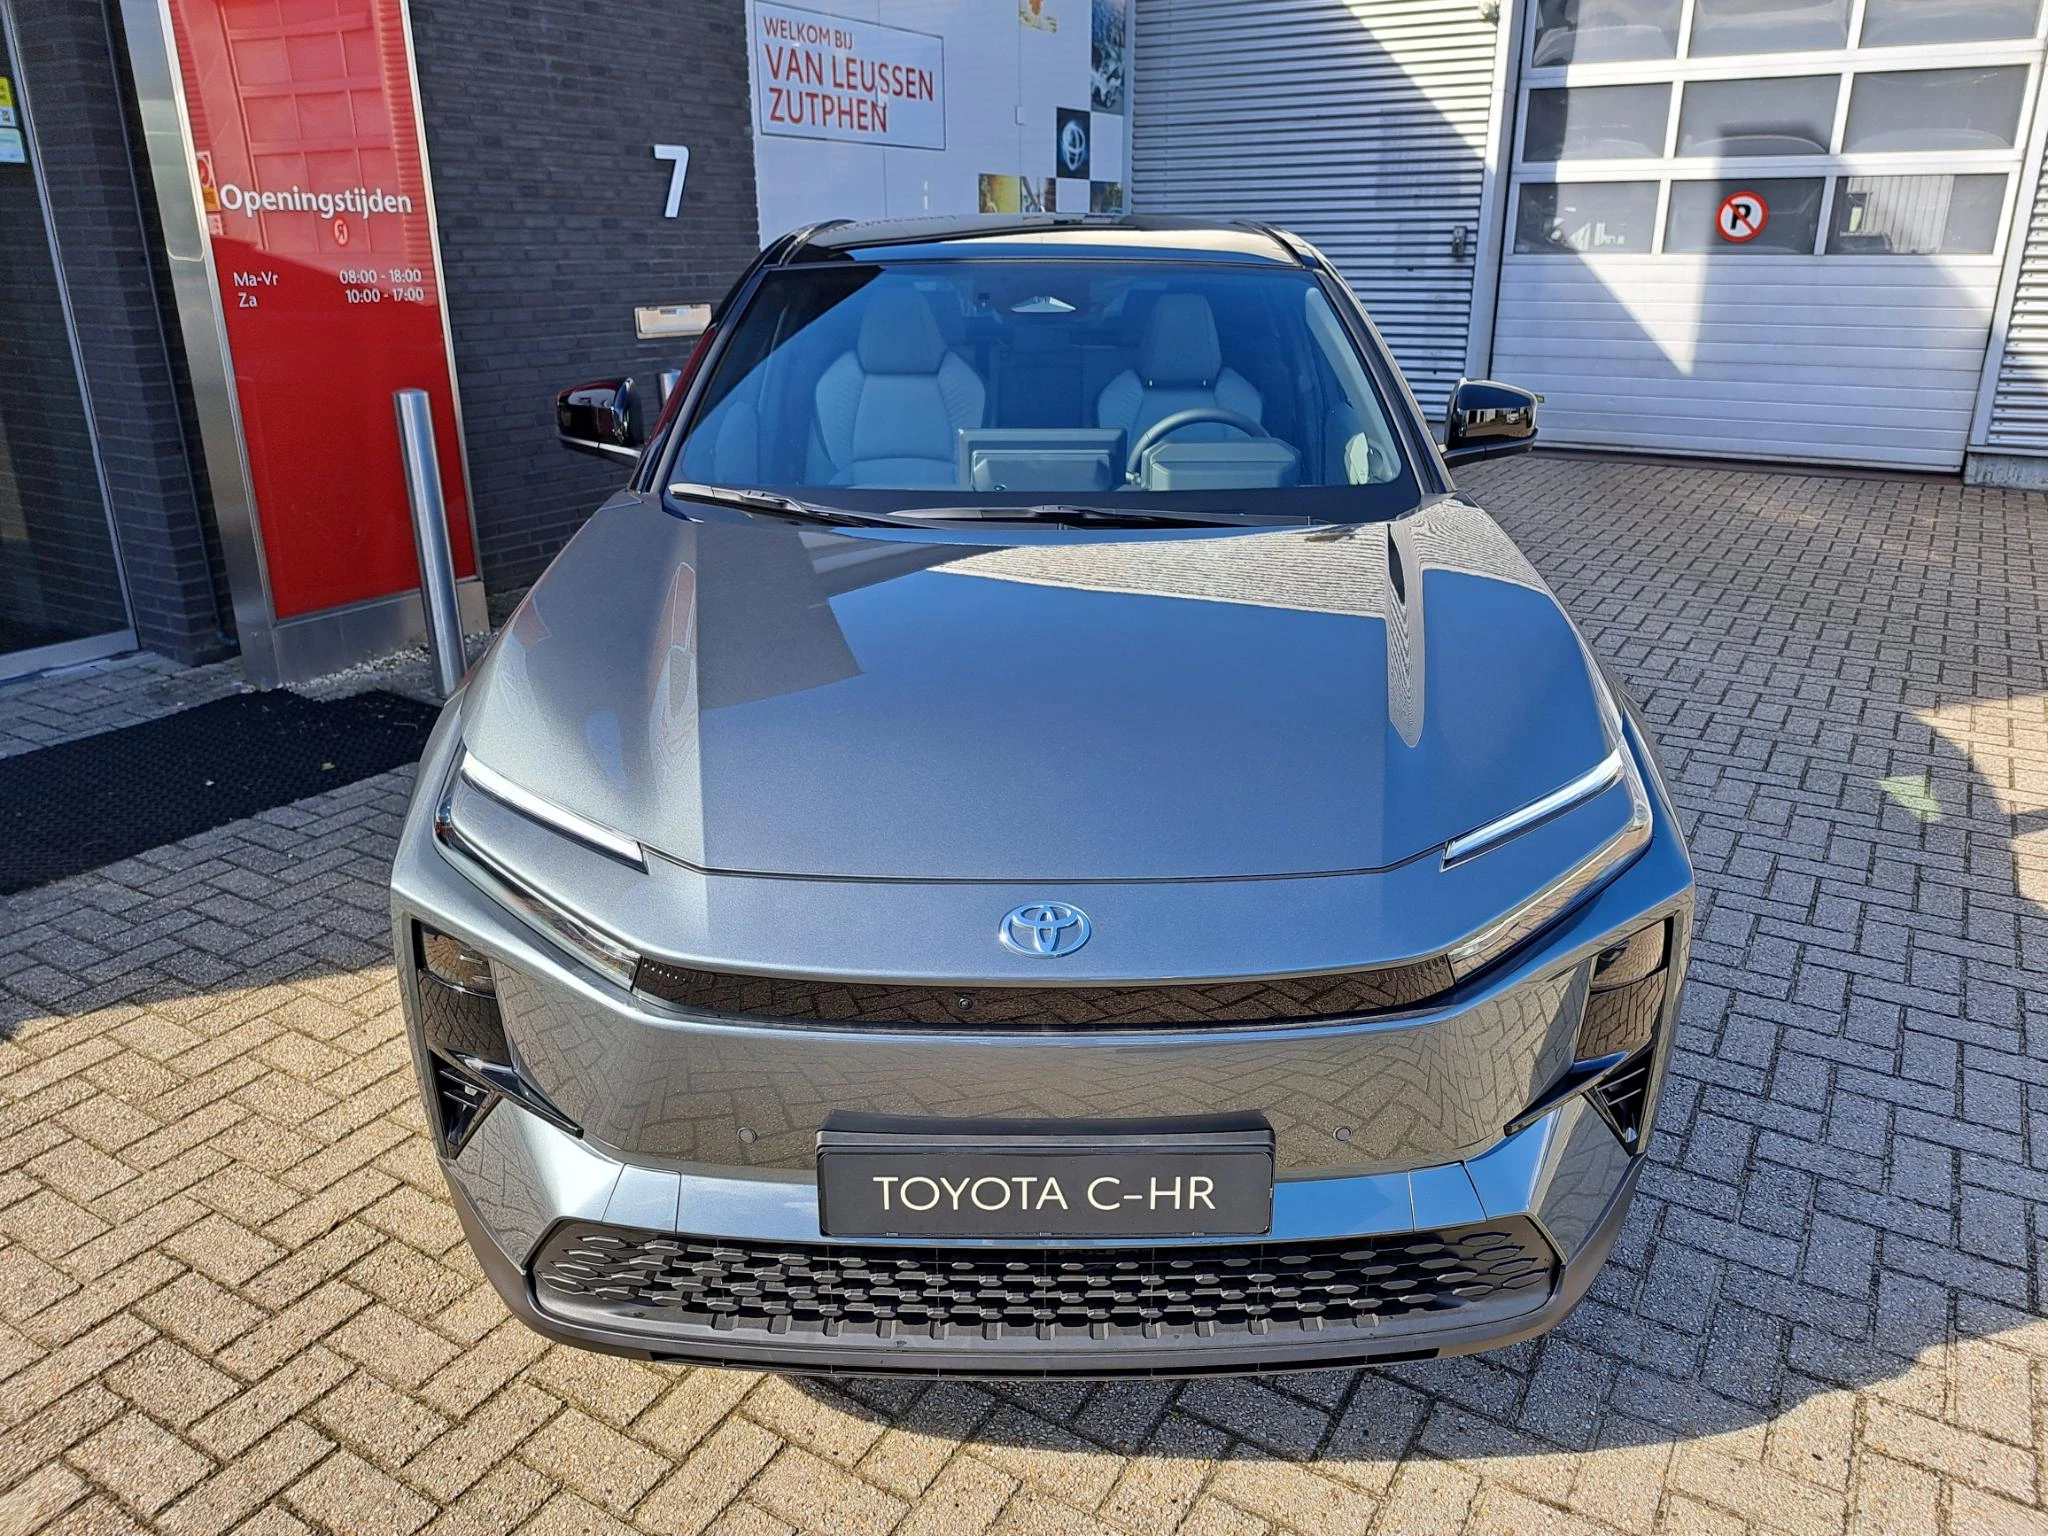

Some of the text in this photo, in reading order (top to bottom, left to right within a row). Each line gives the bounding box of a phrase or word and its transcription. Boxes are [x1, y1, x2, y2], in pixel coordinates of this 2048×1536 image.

[763, 16, 853, 50] WELKOM BIJ
[764, 44, 934, 101] VAN LEUSSEN
[768, 87, 888, 133] ZUTPHEN
[653, 143, 690, 218] 7
[219, 183, 413, 220] Openingstijden
[1730, 204, 1751, 230] P
[233, 271, 279, 287] Ma-Vr
[339, 269, 377, 284] 08:00
[390, 268, 422, 284] 18:00
[238, 291, 258, 308] Za
[345, 289, 381, 304] 10:00
[392, 287, 424, 303] 17:00
[872, 1176, 1217, 1211] TOYOTA C-HR
